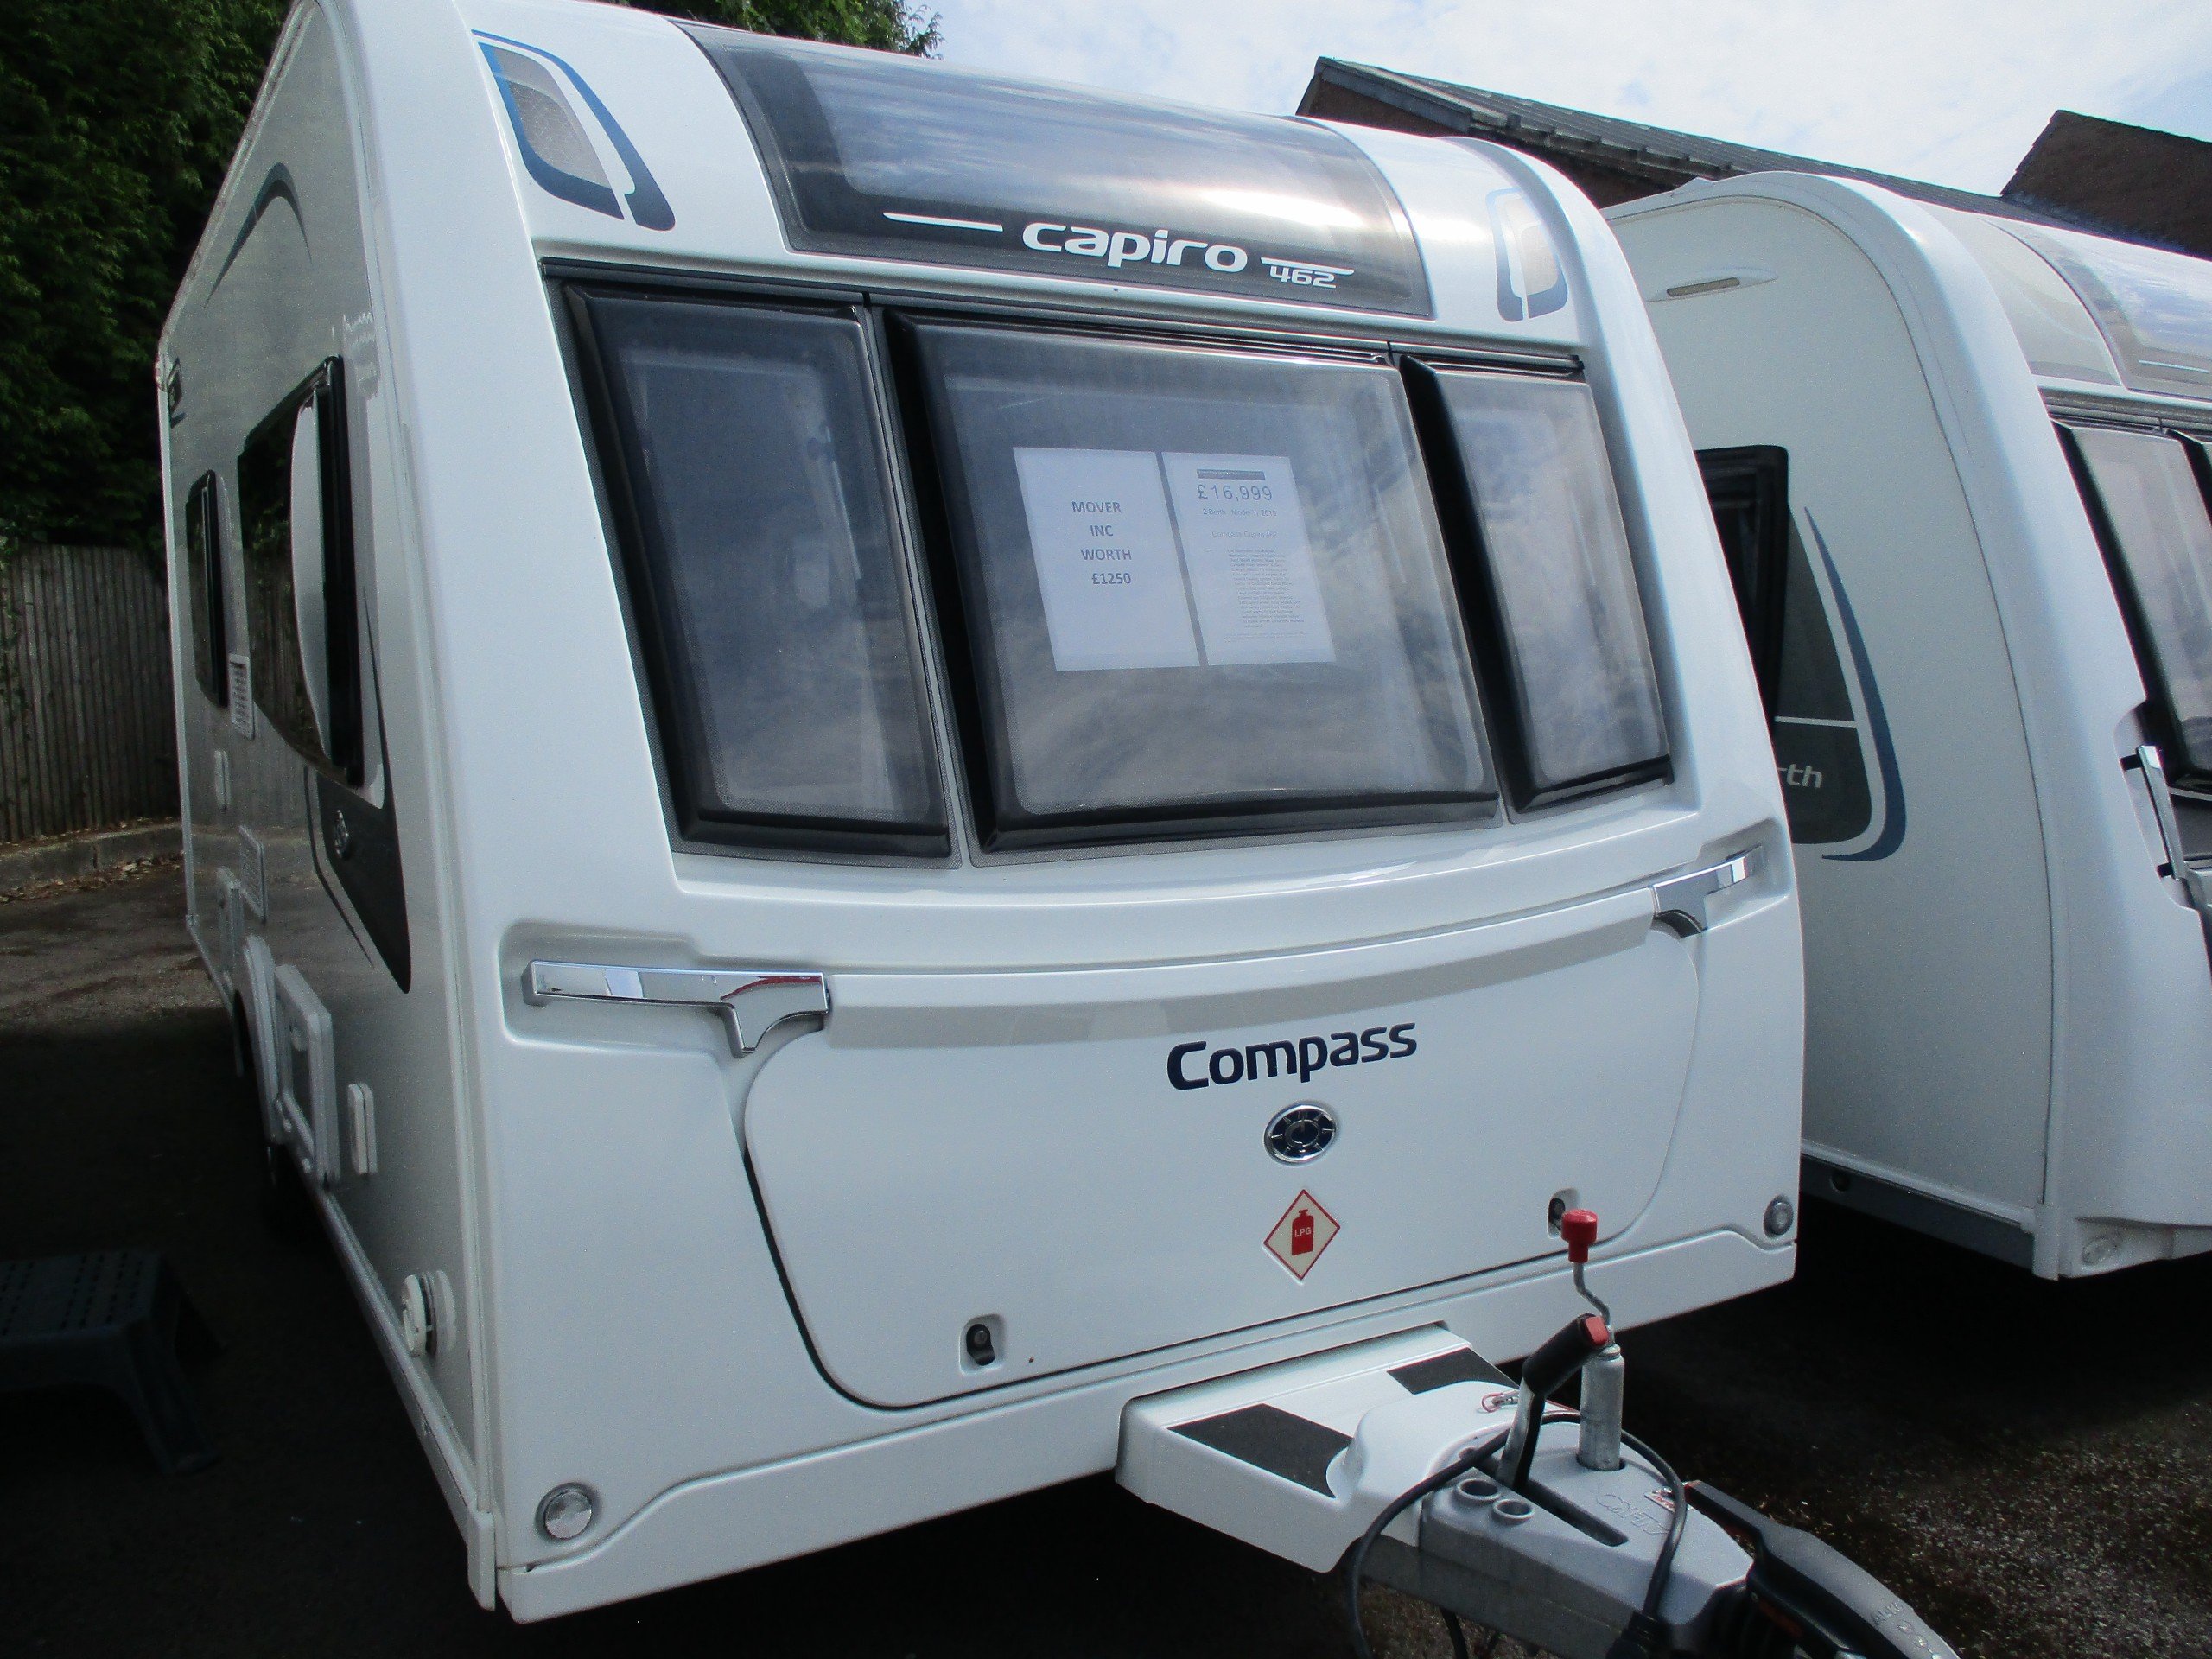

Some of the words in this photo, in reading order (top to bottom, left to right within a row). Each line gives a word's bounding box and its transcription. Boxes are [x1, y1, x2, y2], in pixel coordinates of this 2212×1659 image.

[1022, 222, 1248, 273] capiro
[1270, 266, 1337, 289] 462
[1197, 484, 1272, 502] £16,999
[1071, 500, 1122, 513] MOVER
[1090, 524, 1114, 537] INC
[1080, 548, 1132, 561] WORTH
[1091, 571, 1131, 585] £1250
[1777, 763, 1824, 789] th
[1166, 1022, 1418, 1091] Compass
[1294, 1226, 1312, 1238] LPG
